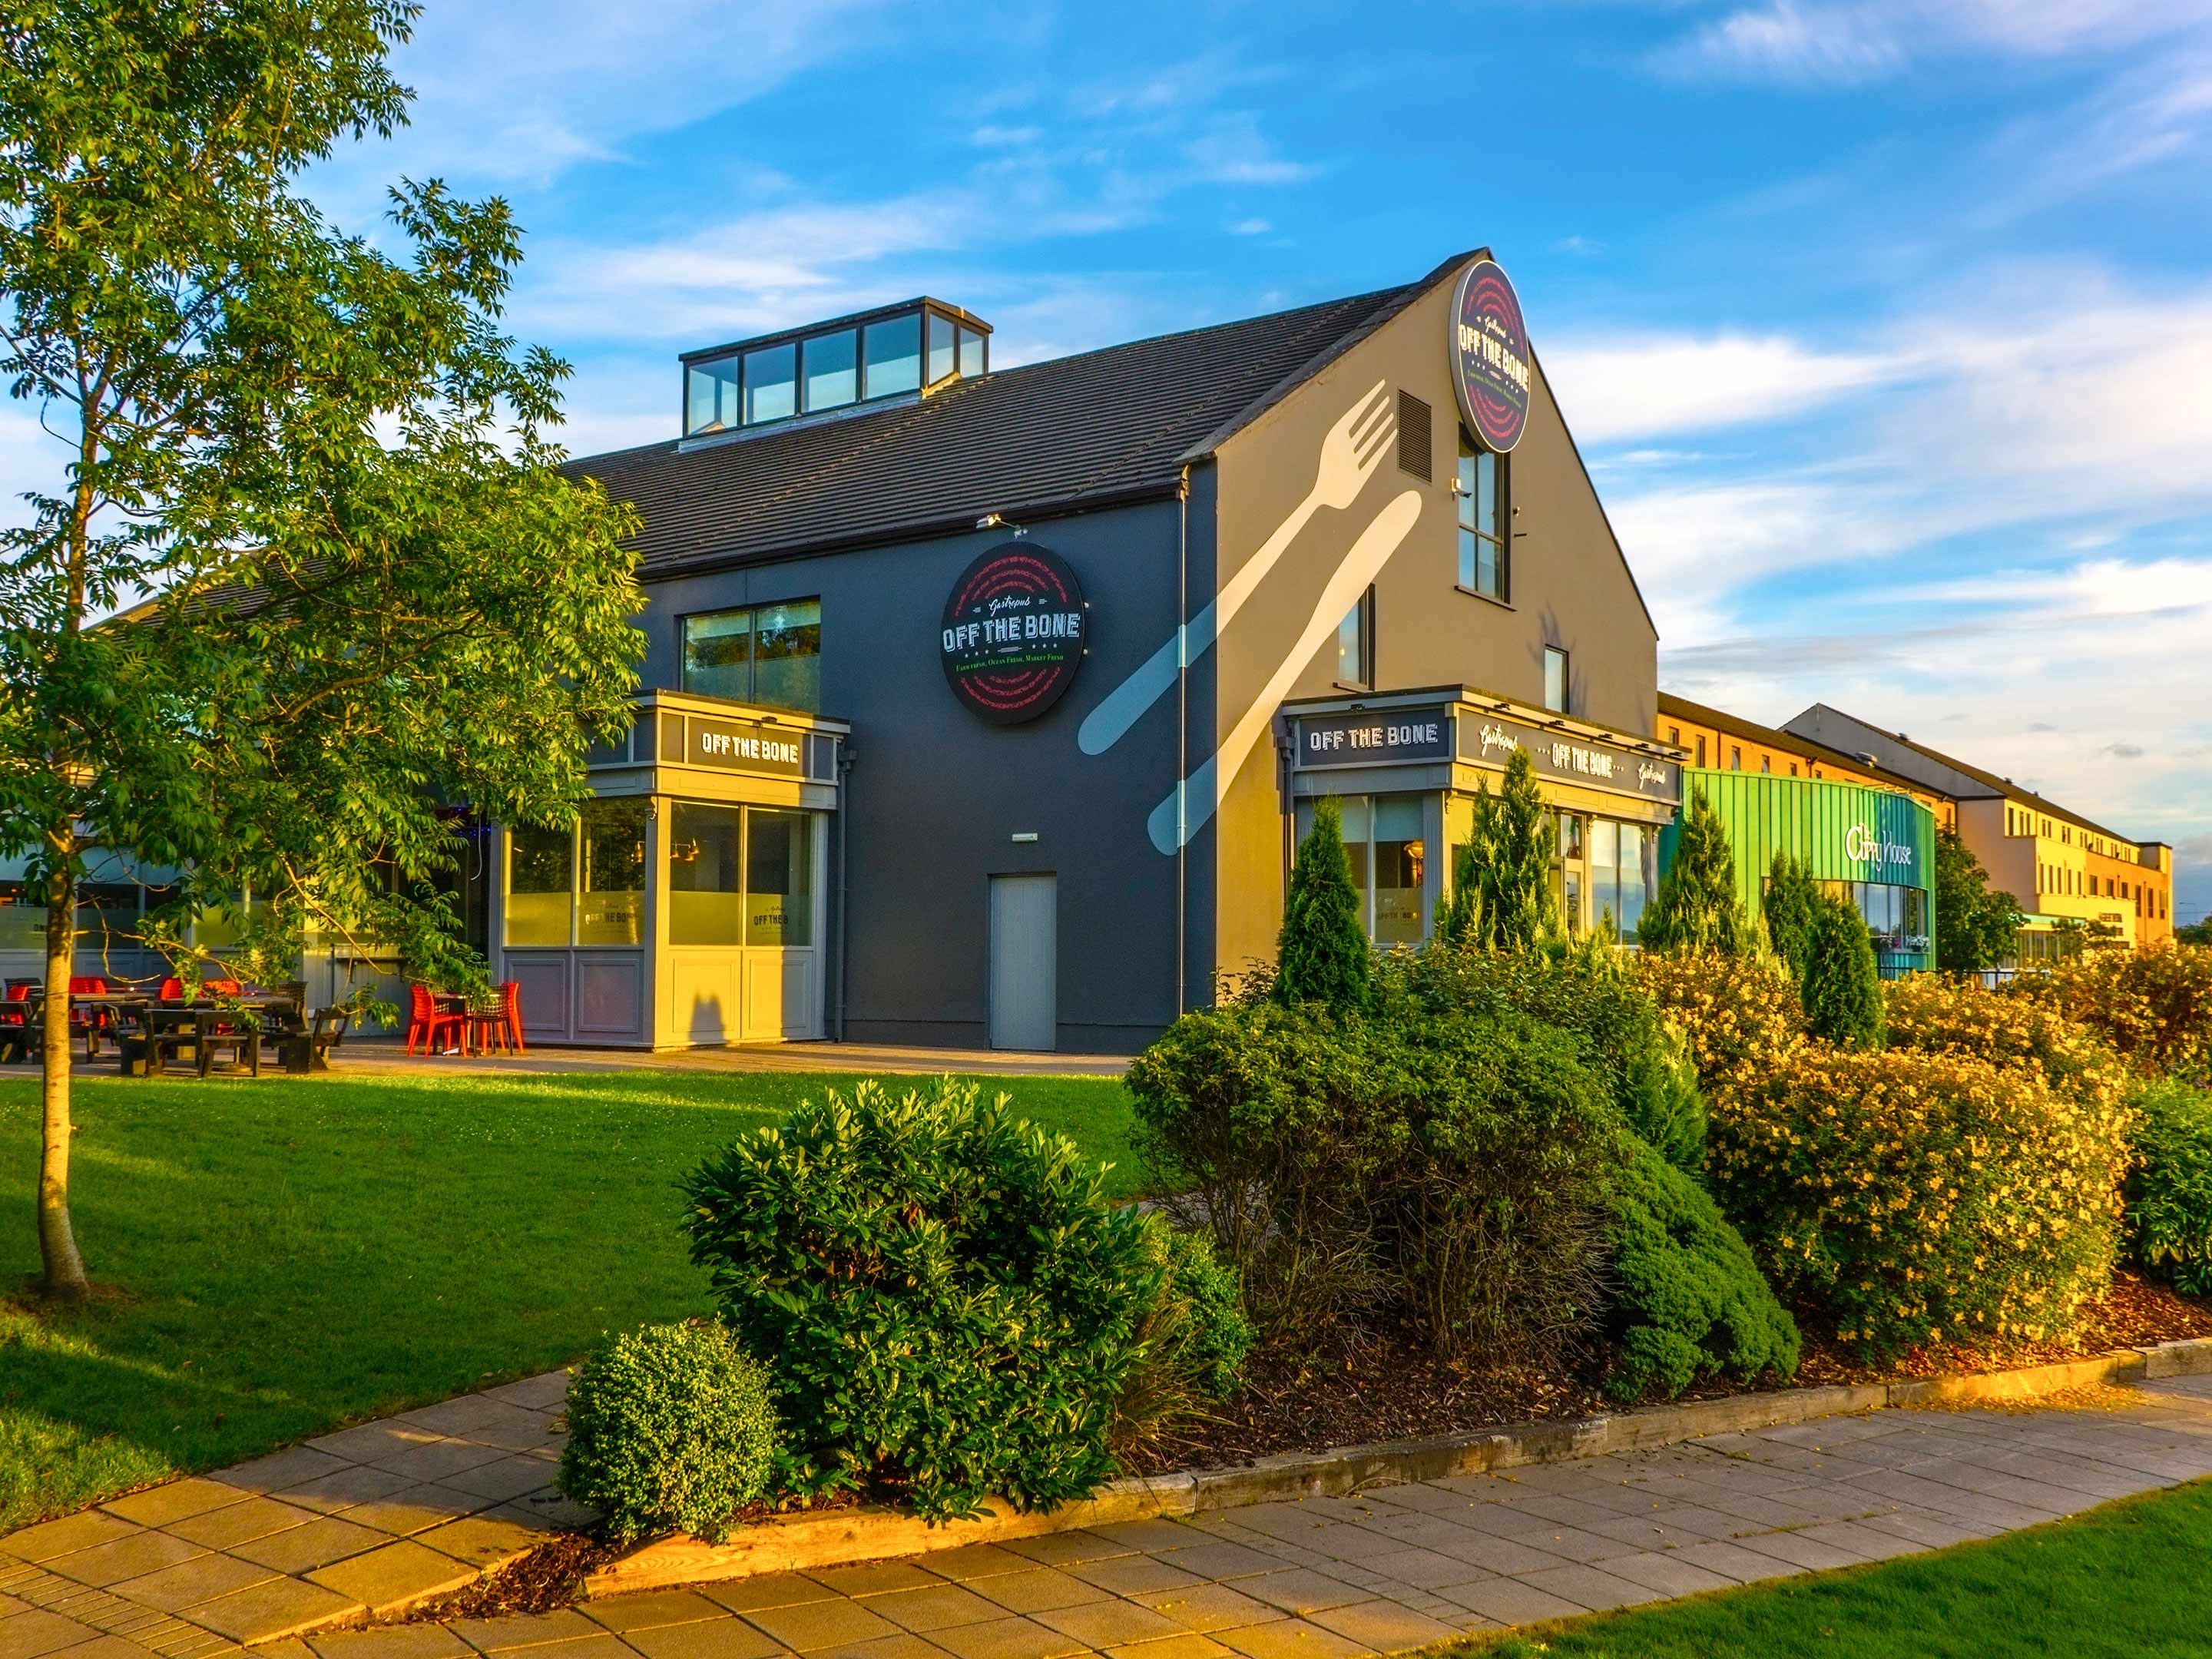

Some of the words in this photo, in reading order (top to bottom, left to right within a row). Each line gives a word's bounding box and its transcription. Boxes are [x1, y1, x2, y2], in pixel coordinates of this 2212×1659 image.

[1459, 324, 1481, 356] OFF
[1482, 333, 1502, 369] THE
[1502, 348, 1529, 392] BONE
[988, 594, 1031, 618] Gastropub
[942, 623, 980, 652] OFF
[983, 616, 1022, 644] THE
[1025, 613, 1081, 639] BONE
[702, 733, 731, 755] OFF
[732, 737, 760, 759] THE
[761, 740, 799, 763] BONE
[1310, 730, 1344, 750] OFF
[1348, 727, 1383, 749] THE
[1387, 723, 1439, 747] BONE
[1552, 743, 1571, 769] OFF
[1571, 747, 1589, 773] THE
[1589, 751, 1613, 779] BONE
[1845, 826, 1882, 872] Curry
[1882, 830, 1912, 866] House
